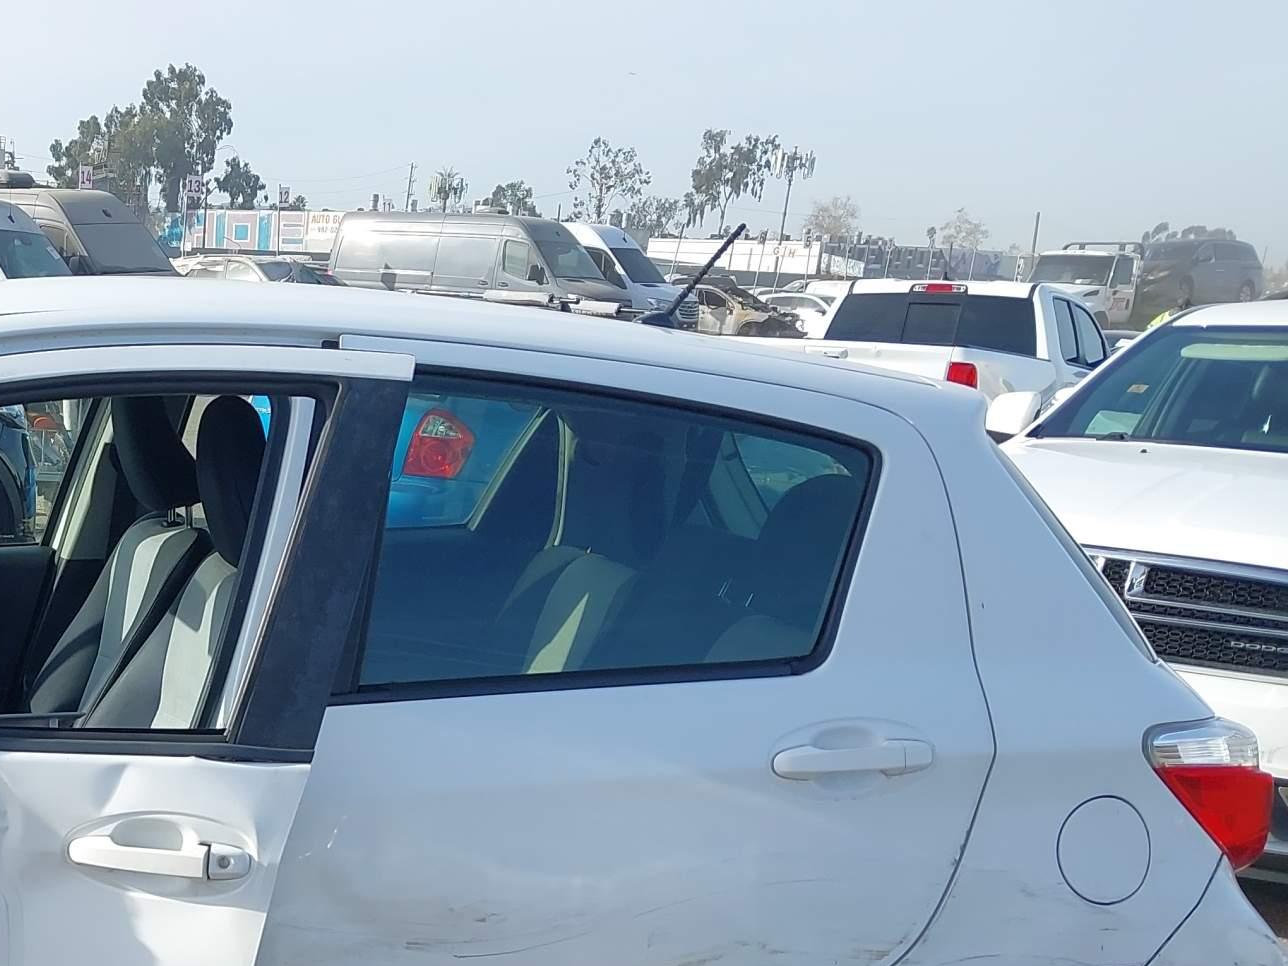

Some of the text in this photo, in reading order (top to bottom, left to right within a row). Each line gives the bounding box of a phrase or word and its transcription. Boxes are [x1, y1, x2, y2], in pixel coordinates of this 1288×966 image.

[81, 170, 92, 184] 14
[187, 180, 201, 193] 13
[279, 191, 290, 203] 12
[805, 235, 812, 247] 5
